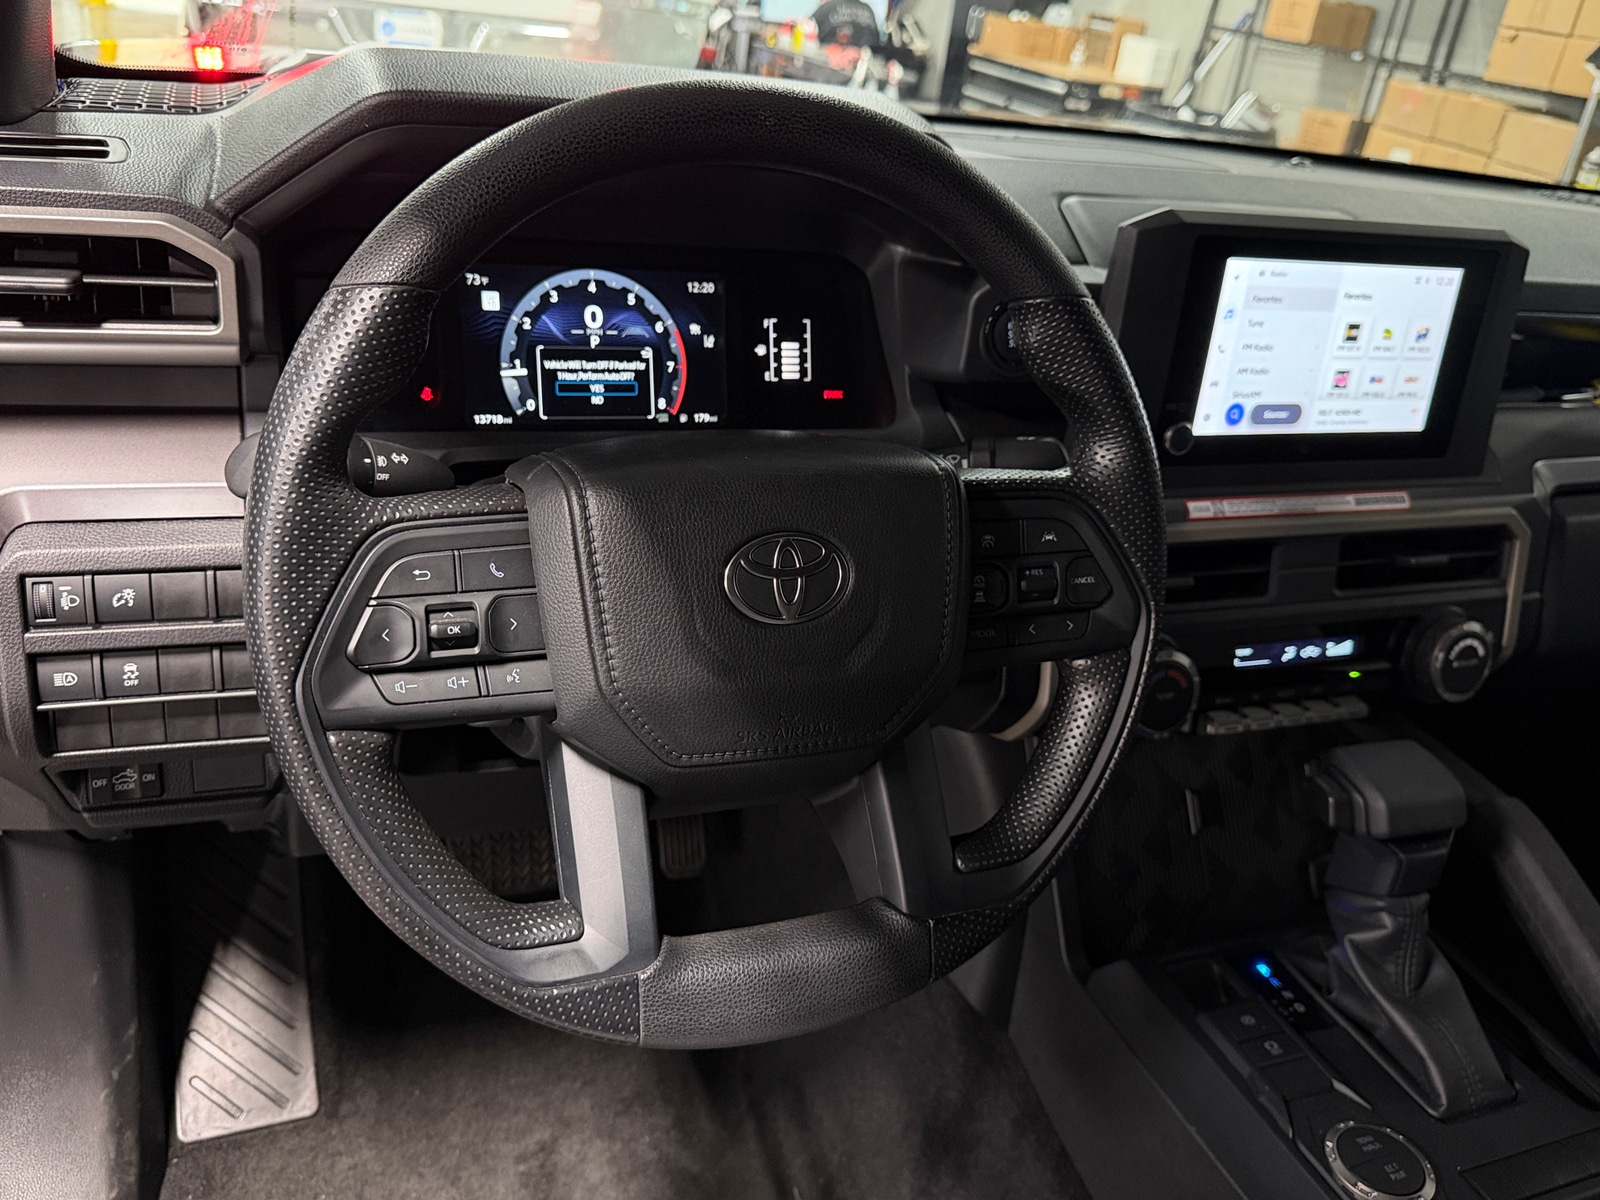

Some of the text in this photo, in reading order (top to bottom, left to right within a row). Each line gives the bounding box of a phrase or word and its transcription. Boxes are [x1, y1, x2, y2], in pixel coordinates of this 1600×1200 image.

[587, 280, 597, 294] 4
[687, 282, 715, 294] 12:20
[549, 291, 559, 304] 3
[626, 293, 636, 306] 5
[583, 304, 604, 329] 0
[521, 318, 532, 330] 2
[654, 320, 664, 334] 6
[590, 334, 600, 349] P
[513, 358, 521, 370] 1
[666, 361, 675, 373] 7
[589, 384, 605, 394] YES
[526, 399, 536, 412] 0
[590, 396, 604, 406] NO
[657, 397, 667, 410] 8
[376, 473, 390, 481] OFF
[1070, 576, 1095, 585] CANCEL
[447, 626, 461, 634] OK
[124, 679, 139, 687] OFF
[736, 721, 836, 743] SRS AIRBAG
[92, 778, 108, 788] OFF
[142, 773, 156, 782] ON
[115, 782, 136, 791] DOOR
